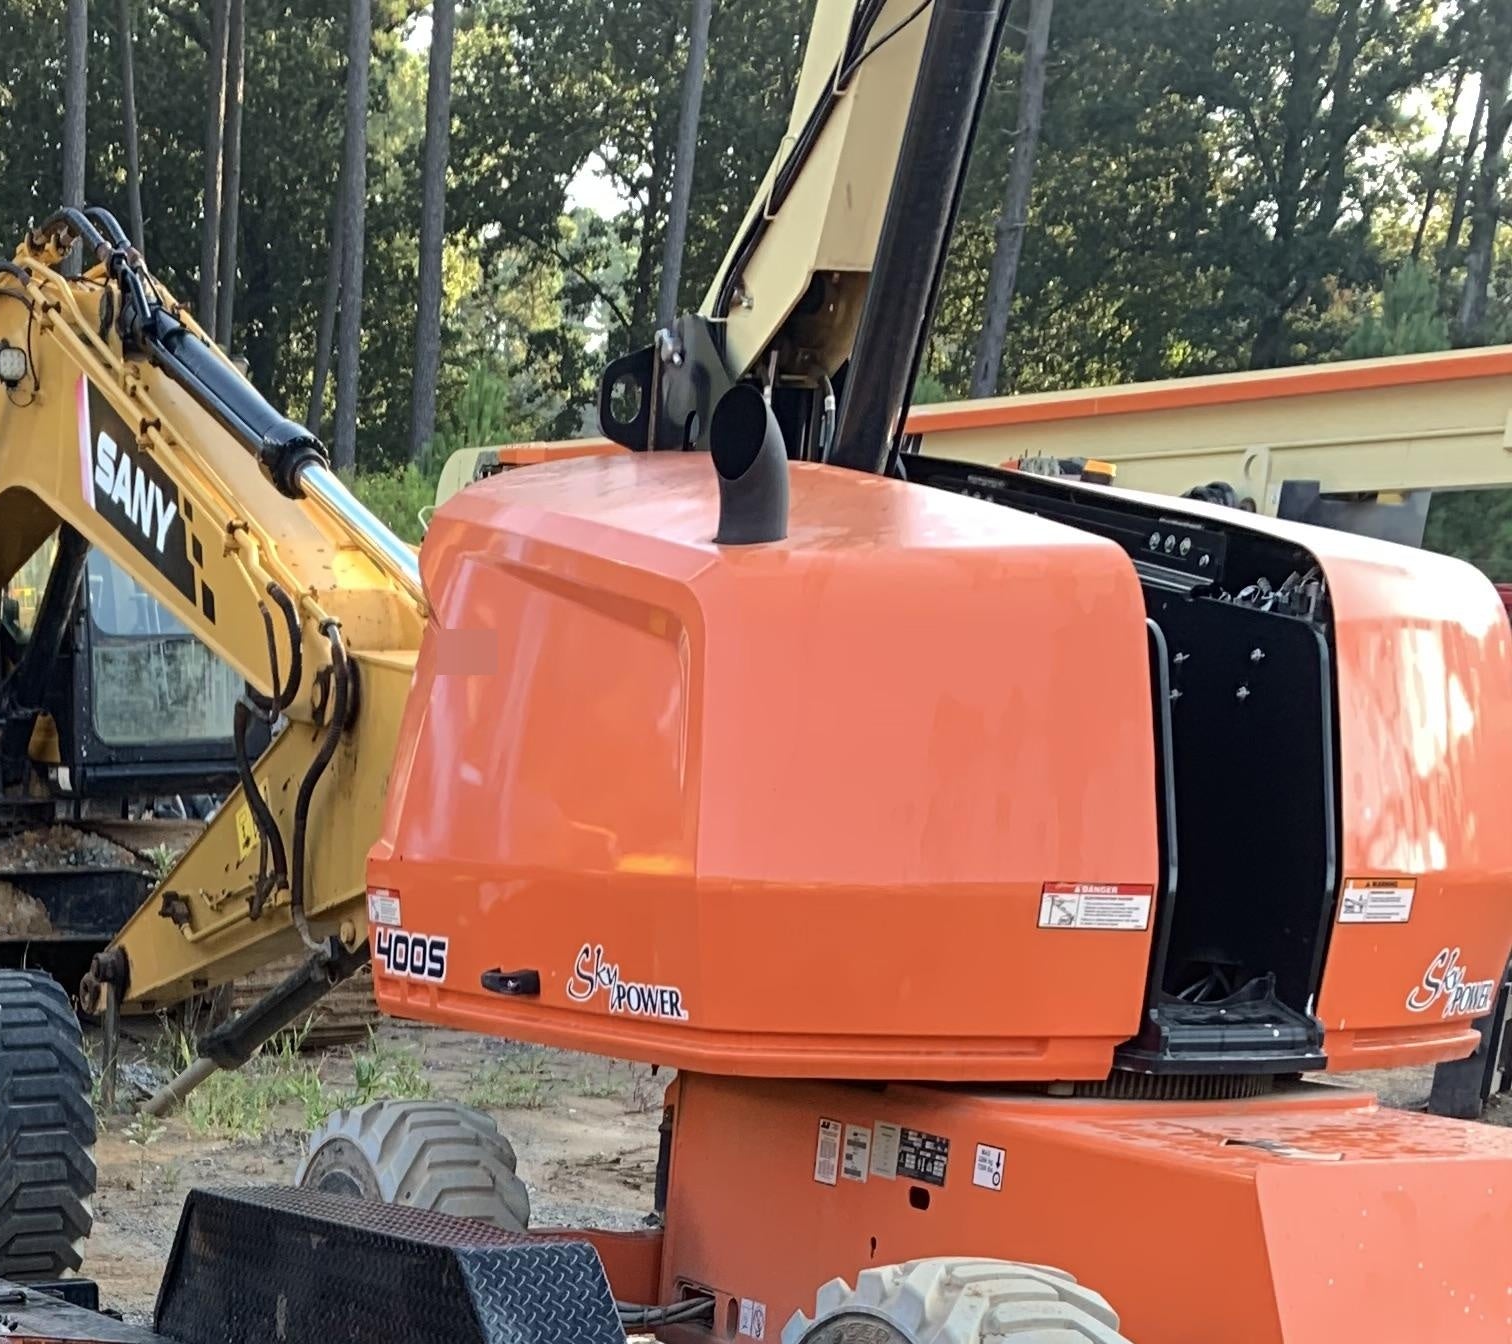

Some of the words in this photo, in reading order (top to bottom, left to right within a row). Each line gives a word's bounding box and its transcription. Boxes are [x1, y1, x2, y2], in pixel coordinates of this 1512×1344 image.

[95, 431, 177, 553] SANY
[376, 930, 447, 980] 400S
[568, 946, 618, 1010] Sky
[614, 983, 682, 1017] POWER
